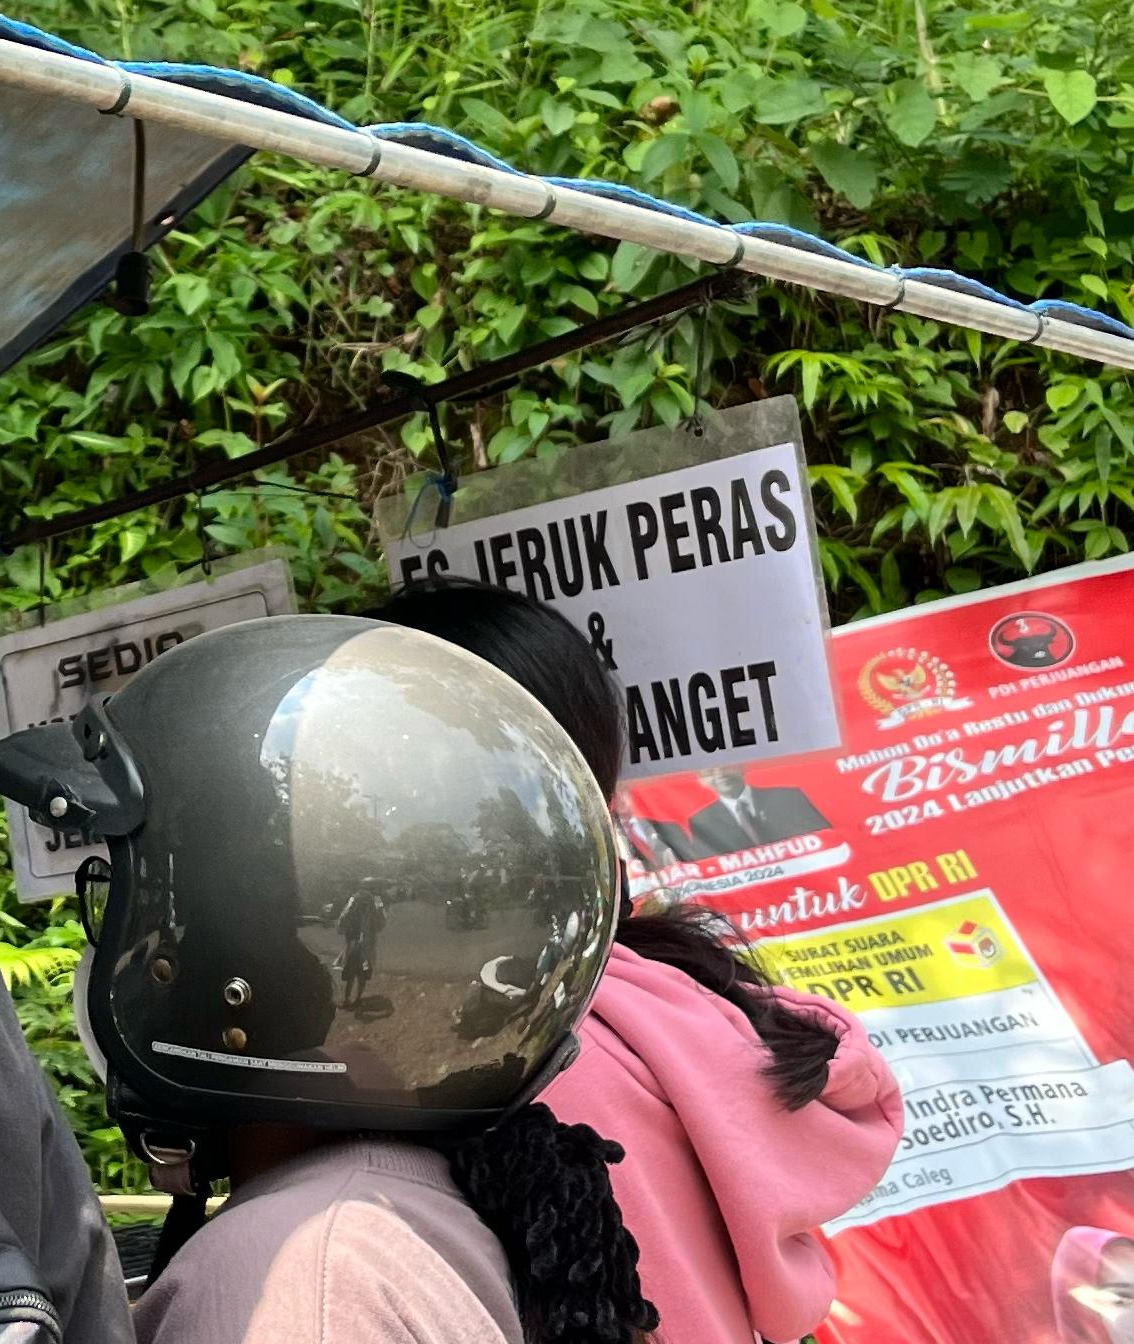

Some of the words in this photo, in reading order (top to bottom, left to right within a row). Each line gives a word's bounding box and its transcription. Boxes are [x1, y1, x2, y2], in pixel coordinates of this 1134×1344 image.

[627, 468, 797, 582] PERAS
[987, 682, 1017, 700] PDI
[1019, 655, 1126, 692] PERJUANGAN
[835, 742, 912, 774] Mohon
[1031, 698, 1074, 720] dan
[864, 799, 946, 836] 2024
[947, 758, 1095, 813] Lanjutkan
[717, 835, 824, 873] MAHFUD
[746, 864, 786, 883] 2024
[739, 875, 868, 931] untuk
[868, 860, 939, 902] DPR
[935, 848, 979, 885] RI
[784, 941, 842, 964] SURAT
[843, 929, 907, 956] SUARA
[873, 942, 935, 967] UMUM
[805, 974, 883, 1003] DPR
[884, 966, 927, 995] RI
[867, 1031, 894, 1050] DI
[897, 1010, 1040, 1045] PERJUANGAN
[904, 1088, 978, 1121] Indra
[977, 1079, 1089, 1106] Permana
[901, 1110, 1006, 1151] Soediro,
[1005, 1102, 1058, 1128] S.H.
[902, 1165, 955, 1190] Caleg
